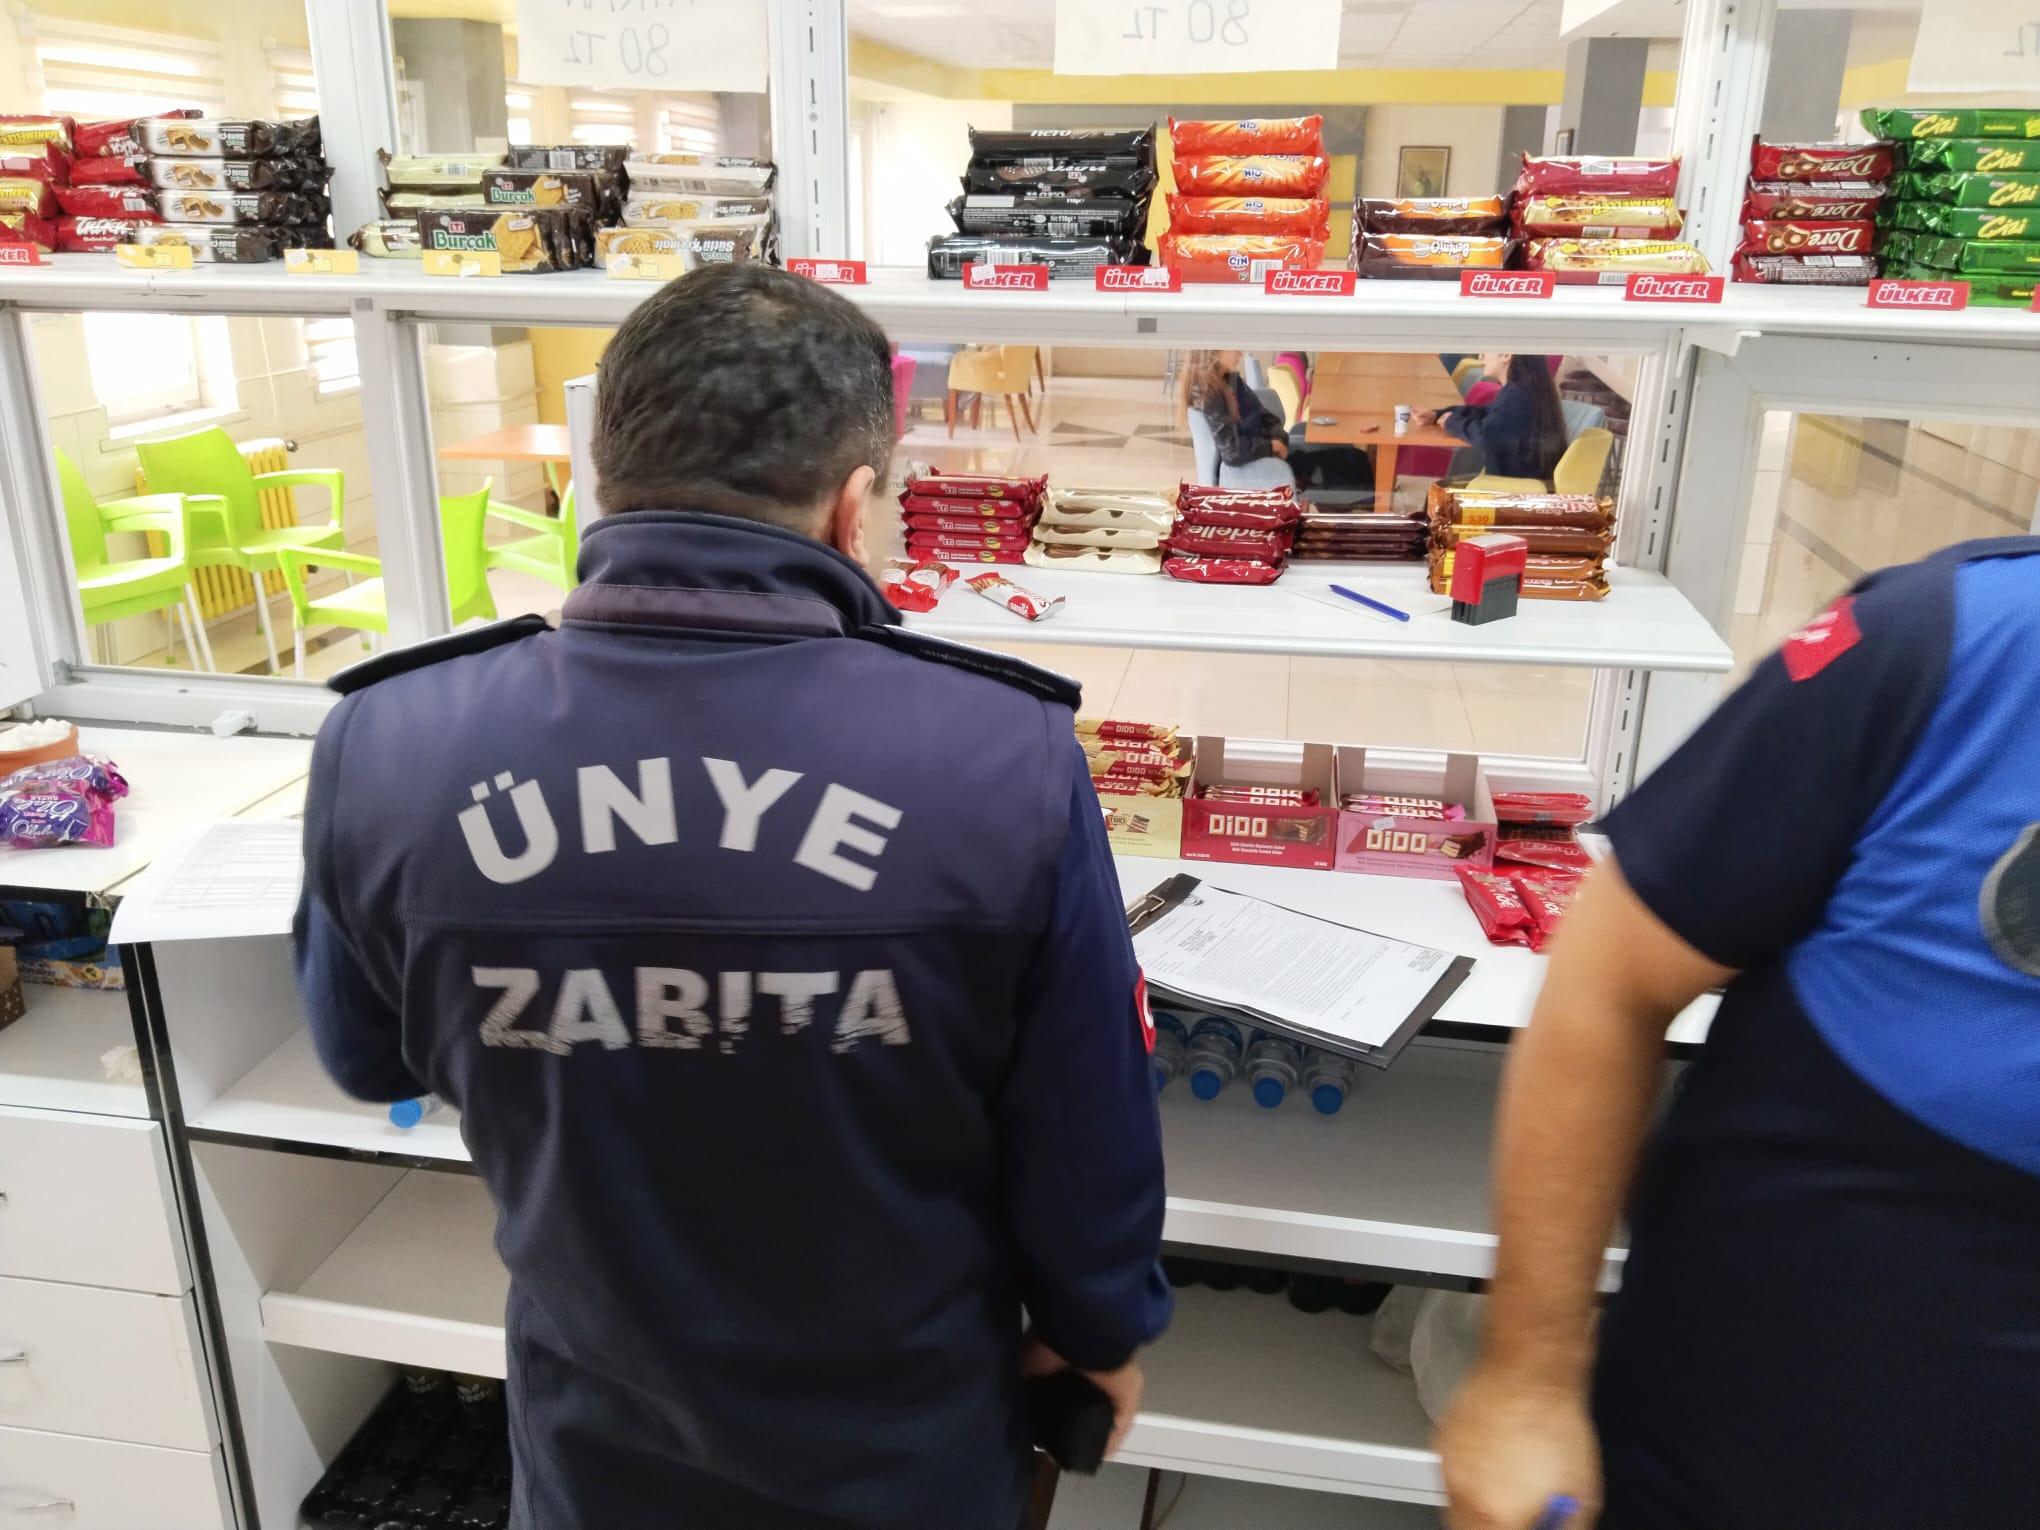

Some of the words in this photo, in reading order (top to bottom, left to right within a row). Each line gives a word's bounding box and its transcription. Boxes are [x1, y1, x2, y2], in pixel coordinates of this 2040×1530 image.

[490, 187, 536, 205] Burçak
[434, 229, 497, 252] Burçak
[1806, 232, 1864, 253] Dore
[1272, 271, 1343, 292] ÜLKER
[1471, 272, 1544, 295] ÜLKER
[1633, 277, 1709, 299] ÜLKER
[1876, 283, 1954, 306] ÜLKER
[457, 756, 904, 892] ÜNYE
[470, 965, 912, 1056] ZABITA
